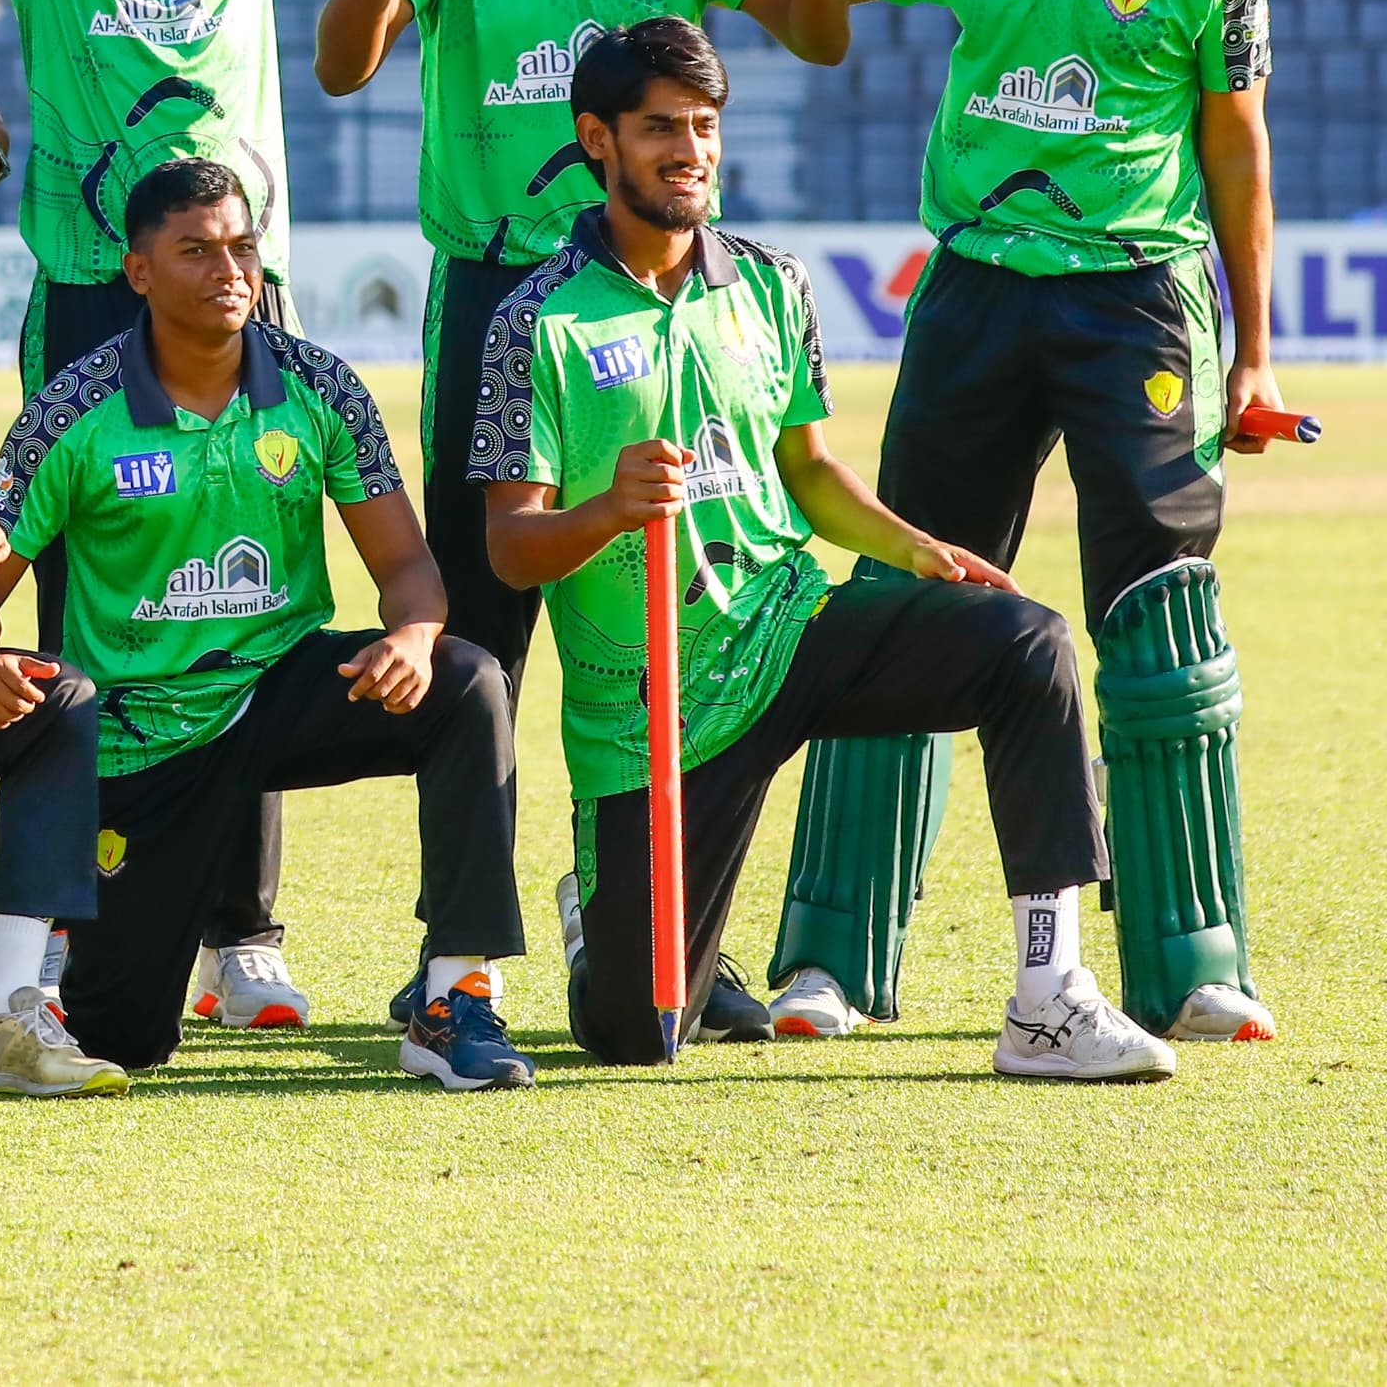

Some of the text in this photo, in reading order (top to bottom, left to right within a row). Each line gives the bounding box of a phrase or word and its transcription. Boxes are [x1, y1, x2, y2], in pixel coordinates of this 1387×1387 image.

[522, 44, 570, 76] aib
[488, 83, 566, 101] Al-Arafah
[1002, 70, 1043, 101] aib
[969, 99, 1126, 133] Al-Arafah Islami Bank
[588, 346, 644, 382] Lily
[114, 460, 173, 494] Lily
[169, 562, 214, 593] aib
[137, 588, 287, 618] Al-Arafah Islami Bank
[1028, 913, 1052, 963] SHREY
